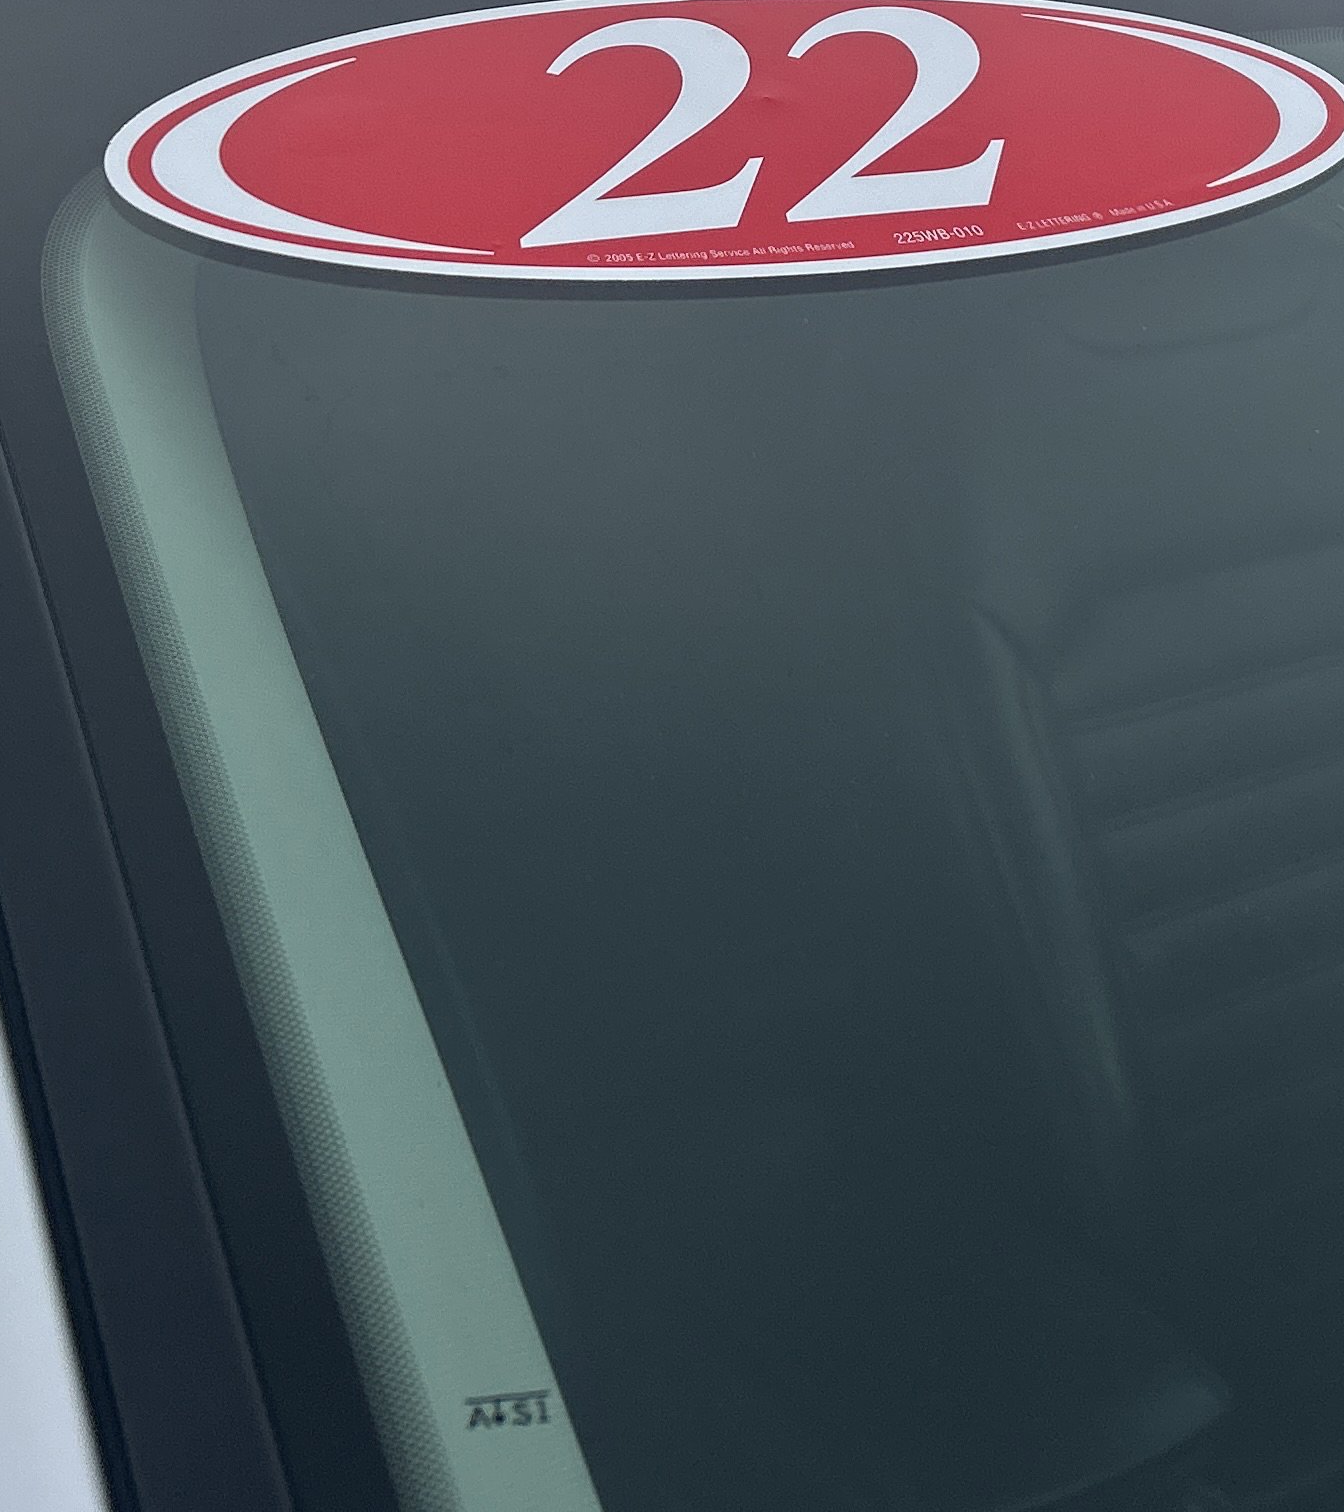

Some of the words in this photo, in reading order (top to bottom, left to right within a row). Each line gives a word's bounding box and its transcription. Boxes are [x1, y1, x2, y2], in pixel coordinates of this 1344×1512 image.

[519, 5, 1006, 249] 22
[1035, 212, 1093, 229] LETTERING
[893, 224, 985, 245] 225WB-010
[605, 252, 634, 263] 2005
[635, 251, 657, 262] E-Z
[658, 250, 709, 262] Lettering
[709, 248, 751, 259] Service
[752, 246, 767, 256] All
[767, 244, 805, 256] Rights
[805, 240, 856, 252] Reserved
